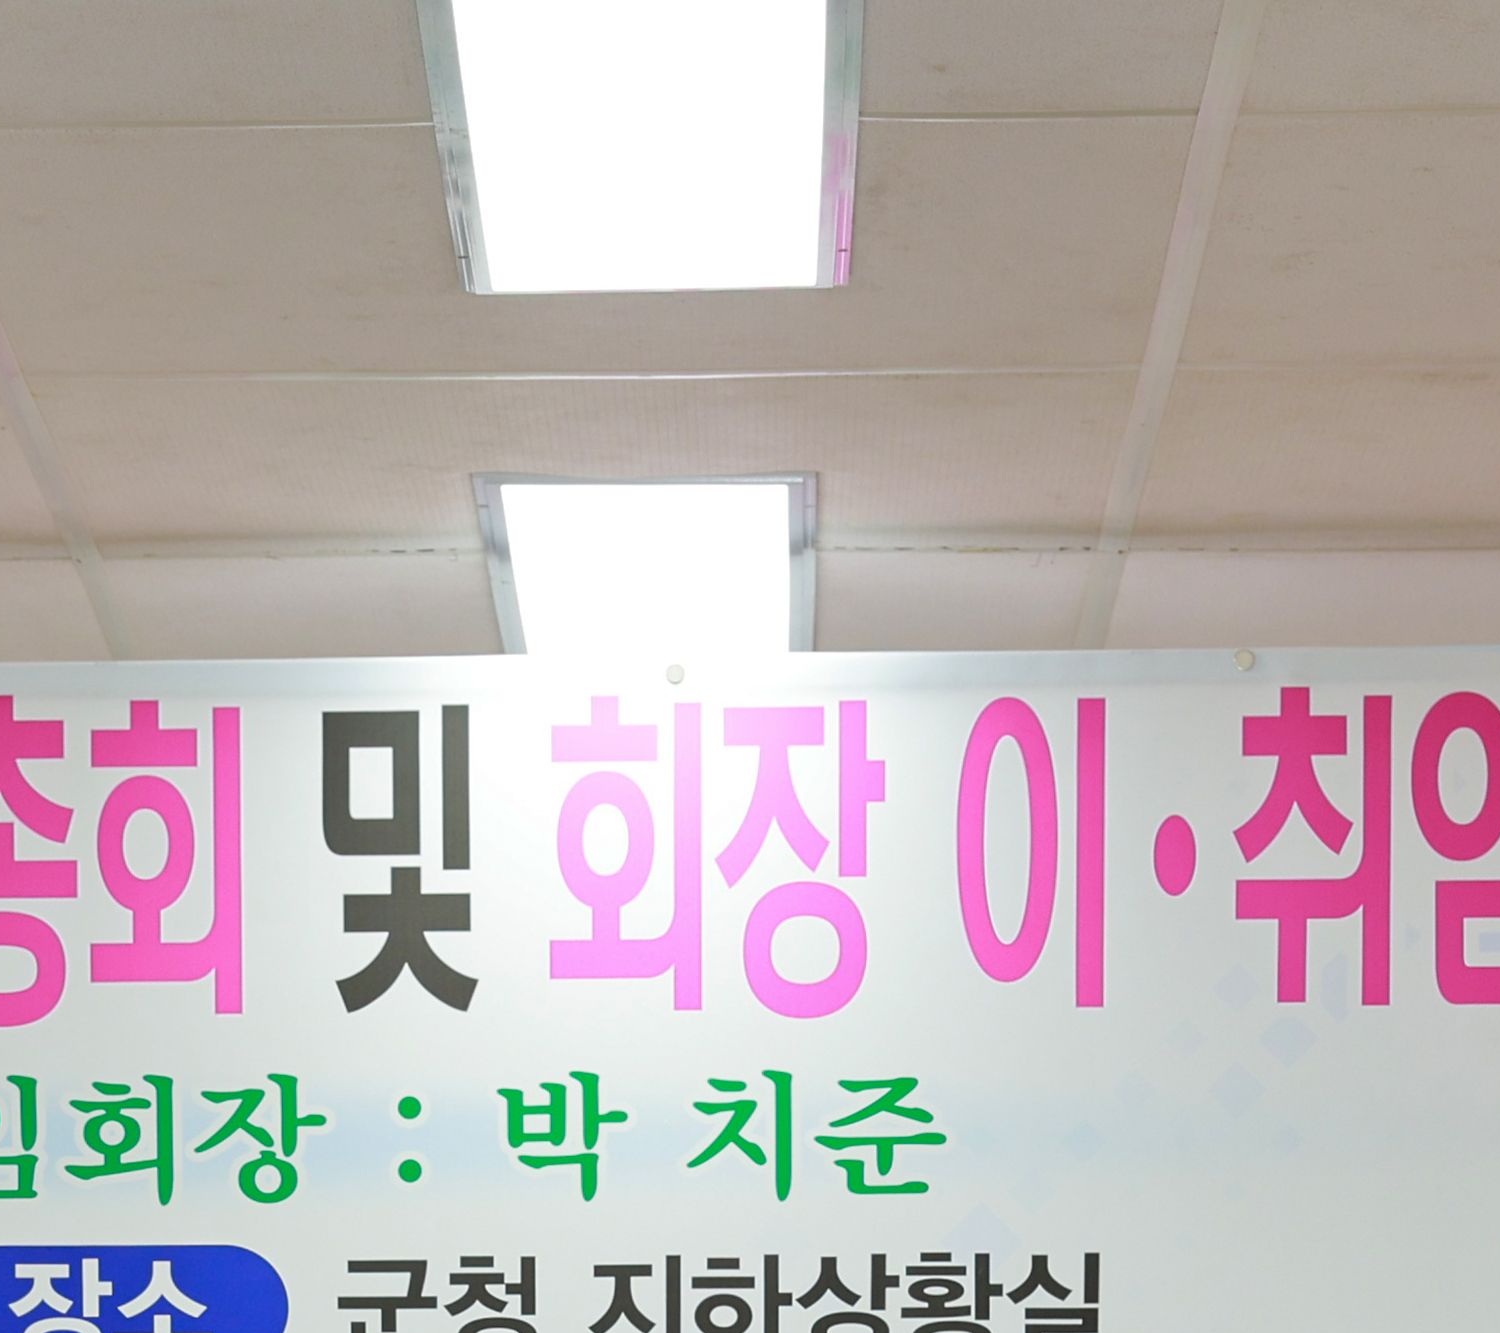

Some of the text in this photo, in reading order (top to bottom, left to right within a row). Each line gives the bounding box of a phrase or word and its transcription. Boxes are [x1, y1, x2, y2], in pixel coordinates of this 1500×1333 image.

[323, 706, 477, 1012] 및
[551, 700, 886, 1019] 회장
[498, 1071, 628, 1201] 박
[688, 1070, 946, 1201] 치준
